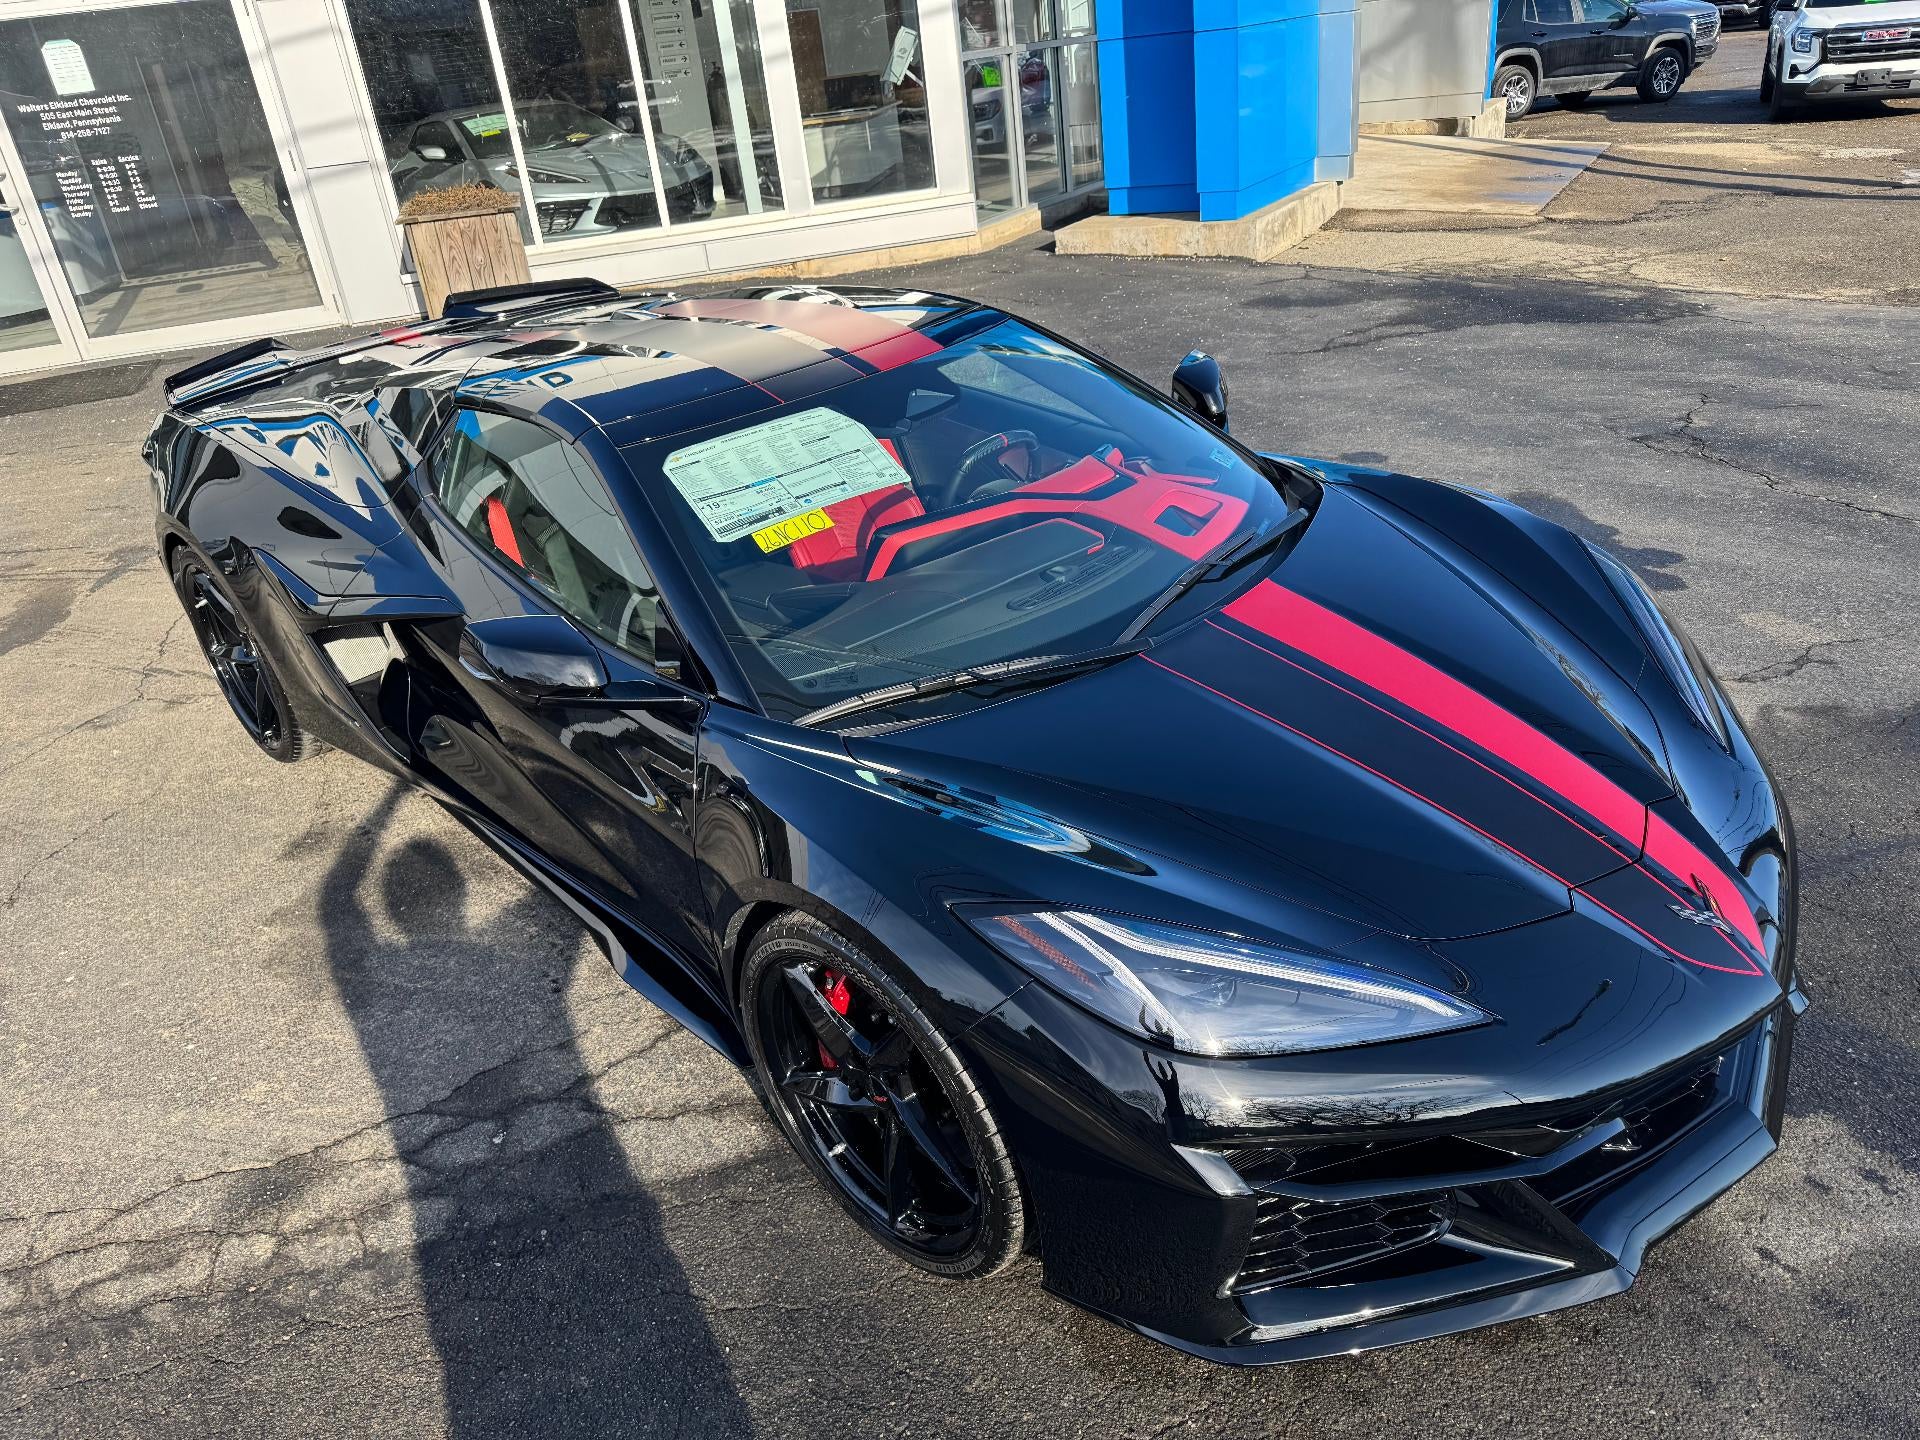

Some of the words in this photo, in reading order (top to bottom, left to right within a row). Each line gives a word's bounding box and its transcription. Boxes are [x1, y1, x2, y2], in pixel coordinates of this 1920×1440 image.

[17, 103, 49, 113] Walters
[49, 100, 78, 111] Elkland
[79, 95, 117, 106] Chevrolet
[117, 94, 132, 102] Inc.
[40, 112, 56, 121] 505
[56, 110, 73, 119] East
[74, 107, 92, 117] Main
[93, 105, 118, 115] Street
[42, 120, 73, 130] Elkland,
[73, 115, 122, 128] Pennsylvania
[56, 170, 78, 178] Monday
[58, 177, 82, 185] Tuesday
[61, 183, 93, 192] Wednesday
[69, 204, 94, 212] Saturday
[137, 194, 156, 203] Closed
[111, 205, 130, 213] Closed
[706, 500, 721, 511] 19
